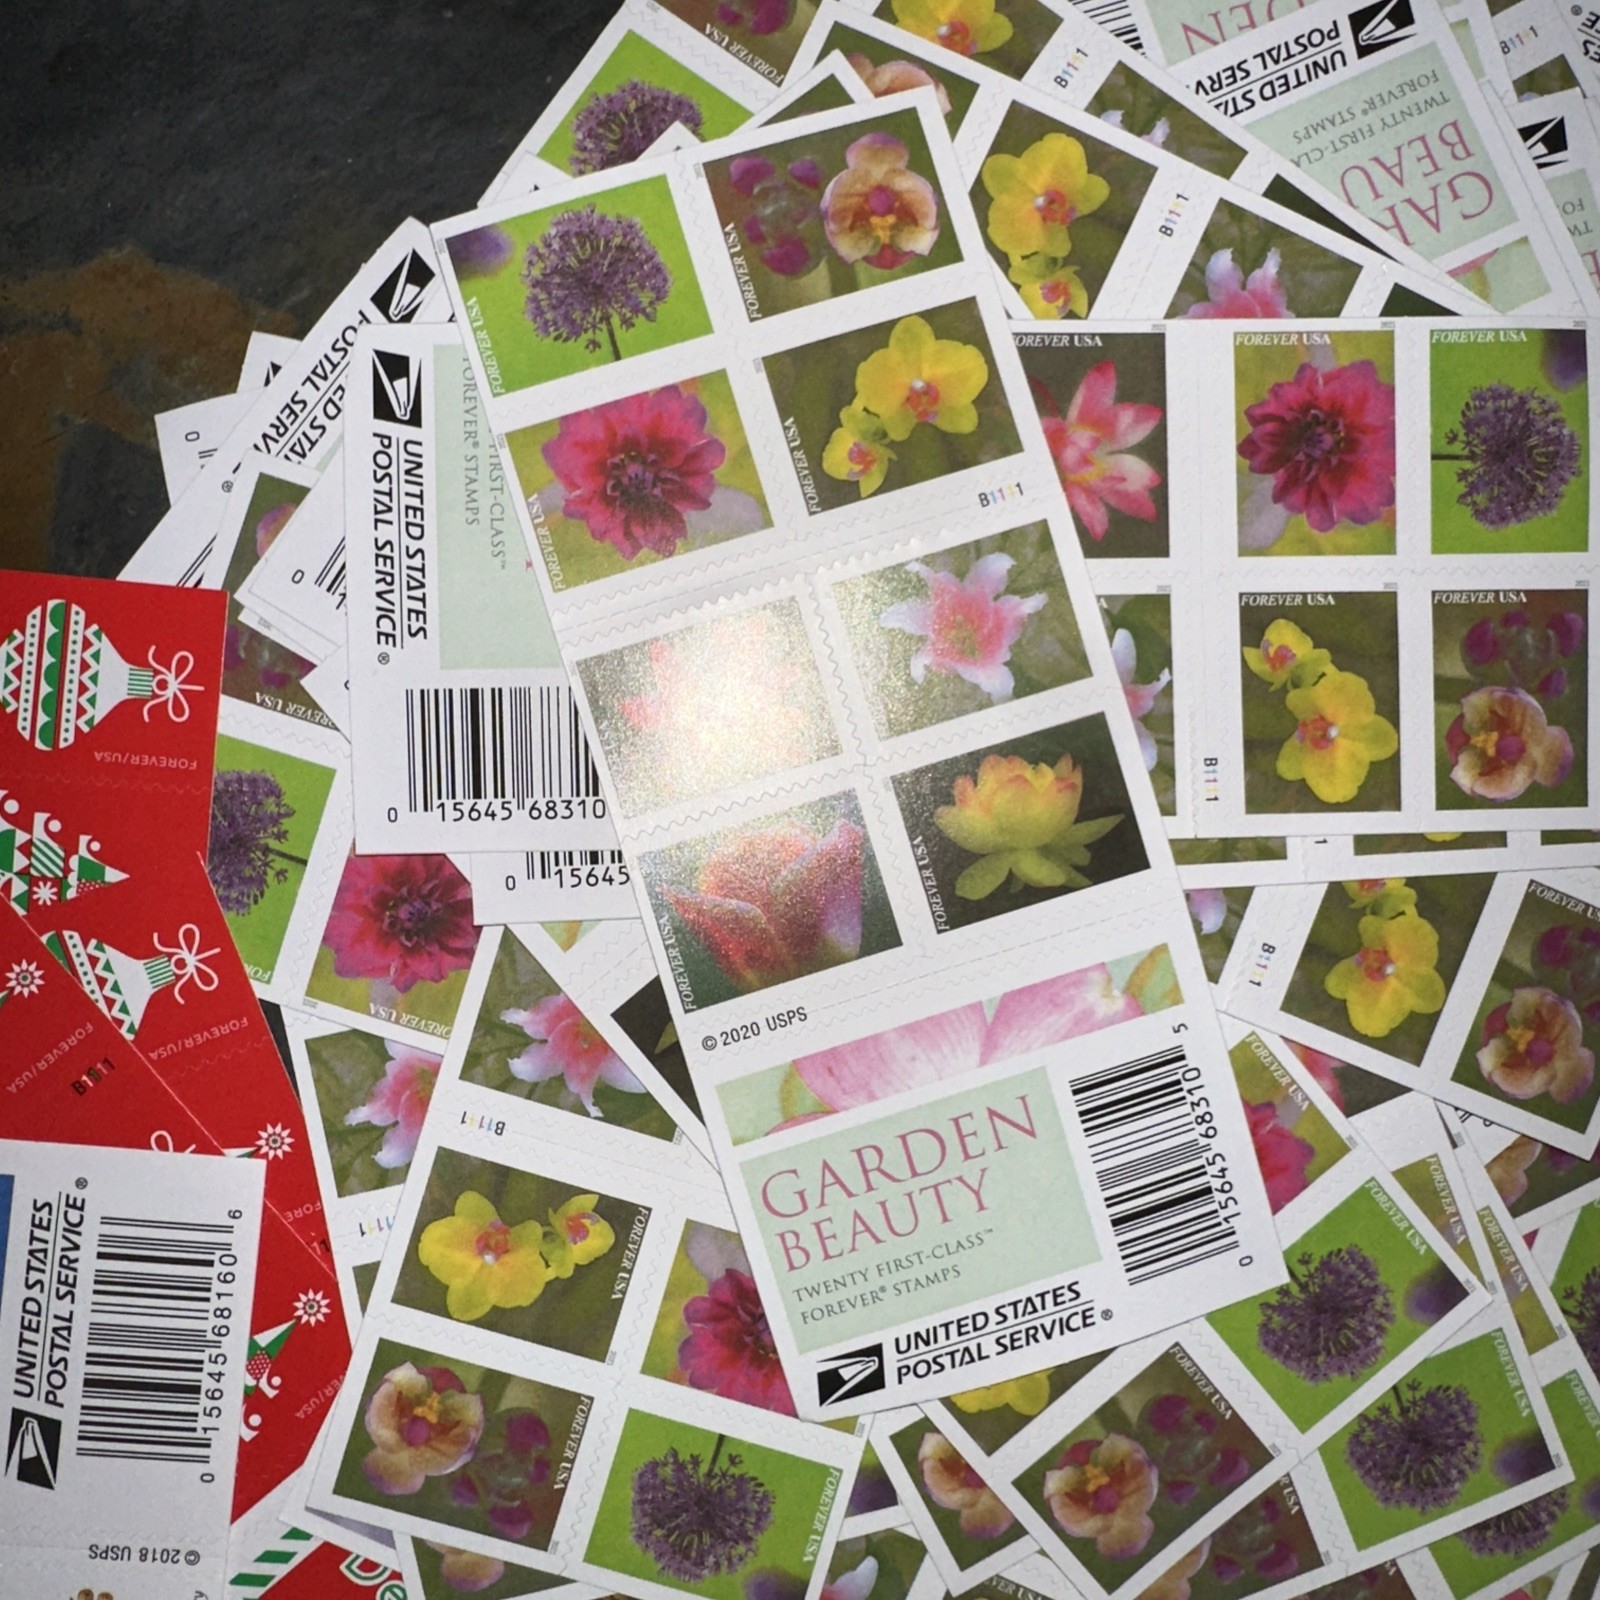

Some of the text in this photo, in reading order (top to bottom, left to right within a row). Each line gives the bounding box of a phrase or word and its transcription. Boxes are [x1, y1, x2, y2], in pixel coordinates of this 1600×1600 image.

[704, 23, 785, 86] FOREVER USA
[1053, 47, 1090, 89] B1111
[1253, 20, 1341, 70] POSTAL
[1194, 60, 1251, 96] SERV
[1259, 49, 1347, 101] UNITED
[1289, 91, 1450, 168] TWENTY FIRST-CLA™
[1292, 107, 1356, 144] STAMPS
[1340, 119, 1475, 210] BEAU
[1159, 192, 1190, 237] B1111
[722, 222, 762, 320] FOREVER USA
[466, 296, 505, 394] FOREVER USA
[1074, 334, 1103, 347] USA
[1235, 332, 1331, 346] FOREVER USA
[1432, 330, 1528, 344] FOREVER USA
[184, 430, 200, 442] 0
[254, 390, 308, 455] SERV
[284, 416, 326, 463] STA
[372, 432, 393, 531] POSTAL
[784, 416, 822, 512] FOREVER USA
[464, 454, 480, 526] STAMPS
[978, 482, 1024, 507] B1111
[403, 439, 428, 640] UNITED STATES
[526, 493, 566, 590] FOREVER USA
[290, 568, 305, 585] 0
[1240, 594, 1336, 607] FOREVER USA
[1434, 590, 1528, 604] FOREVER USA
[256, 692, 335, 728] REVER USA
[94, 751, 197, 770] FOREVER/USA
[1202, 757, 1219, 803] B1111
[387, 798, 606, 822] 0 15645 68310
[505, 866, 630, 890] 0 15645
[913, 836, 949, 931] FOREVER USA
[1528, 882, 1600, 921] FOREVER US
[659, 914, 696, 1010] FOREVER USA
[1249, 942, 1276, 988] B1111
[148, 1016, 249, 1060] FOREVER/USA
[369, 1002, 452, 1037] OREVER USA
[720, 1022, 761, 1046] 2020
[766, 1006, 808, 1032] USPS
[6, 1022, 93, 1094] FOREVER/USA
[70, 1058, 116, 1096] B1111
[1244, 1034, 1310, 1112] FOREVER USA
[461, 1111, 506, 1136] B1111
[1172, 1022, 1253, 1267] 0 15645 68310 5
[761, 1094, 1038, 1219] GARDEN
[775, 1167, 990, 1273] BEAUTY
[1364, 1180, 1428, 1255] FOREVER USA
[1426, 1156, 1468, 1244] FOREVER USA
[611, 1207, 649, 1300] FOREVER USA
[1479, 1209, 1529, 1292] FOREVER USA
[13, 1198, 52, 1398] UNITED STATES
[792, 1267, 870, 1302] TWENTY
[892, 1264, 961, 1298] STAMPS
[894, 1280, 1082, 1355] UNITED STATES
[44, 1310, 74, 1408] POSTAL
[200, 1209, 242, 1483] 0 15645 68160 6
[896, 1340, 990, 1385] POSTAL
[1169, 1345, 1234, 1420] FOREVER USA
[1491, 1331, 1532, 1417] FOREVER USA
[553, 1396, 590, 1490] FOREVER USA
[803, 1468, 841, 1562] FOREVER USA
[1282, 1486, 1300, 1514] USA
[88, 1544, 132, 1562] USPS
[138, 1546, 180, 1564] 2018
